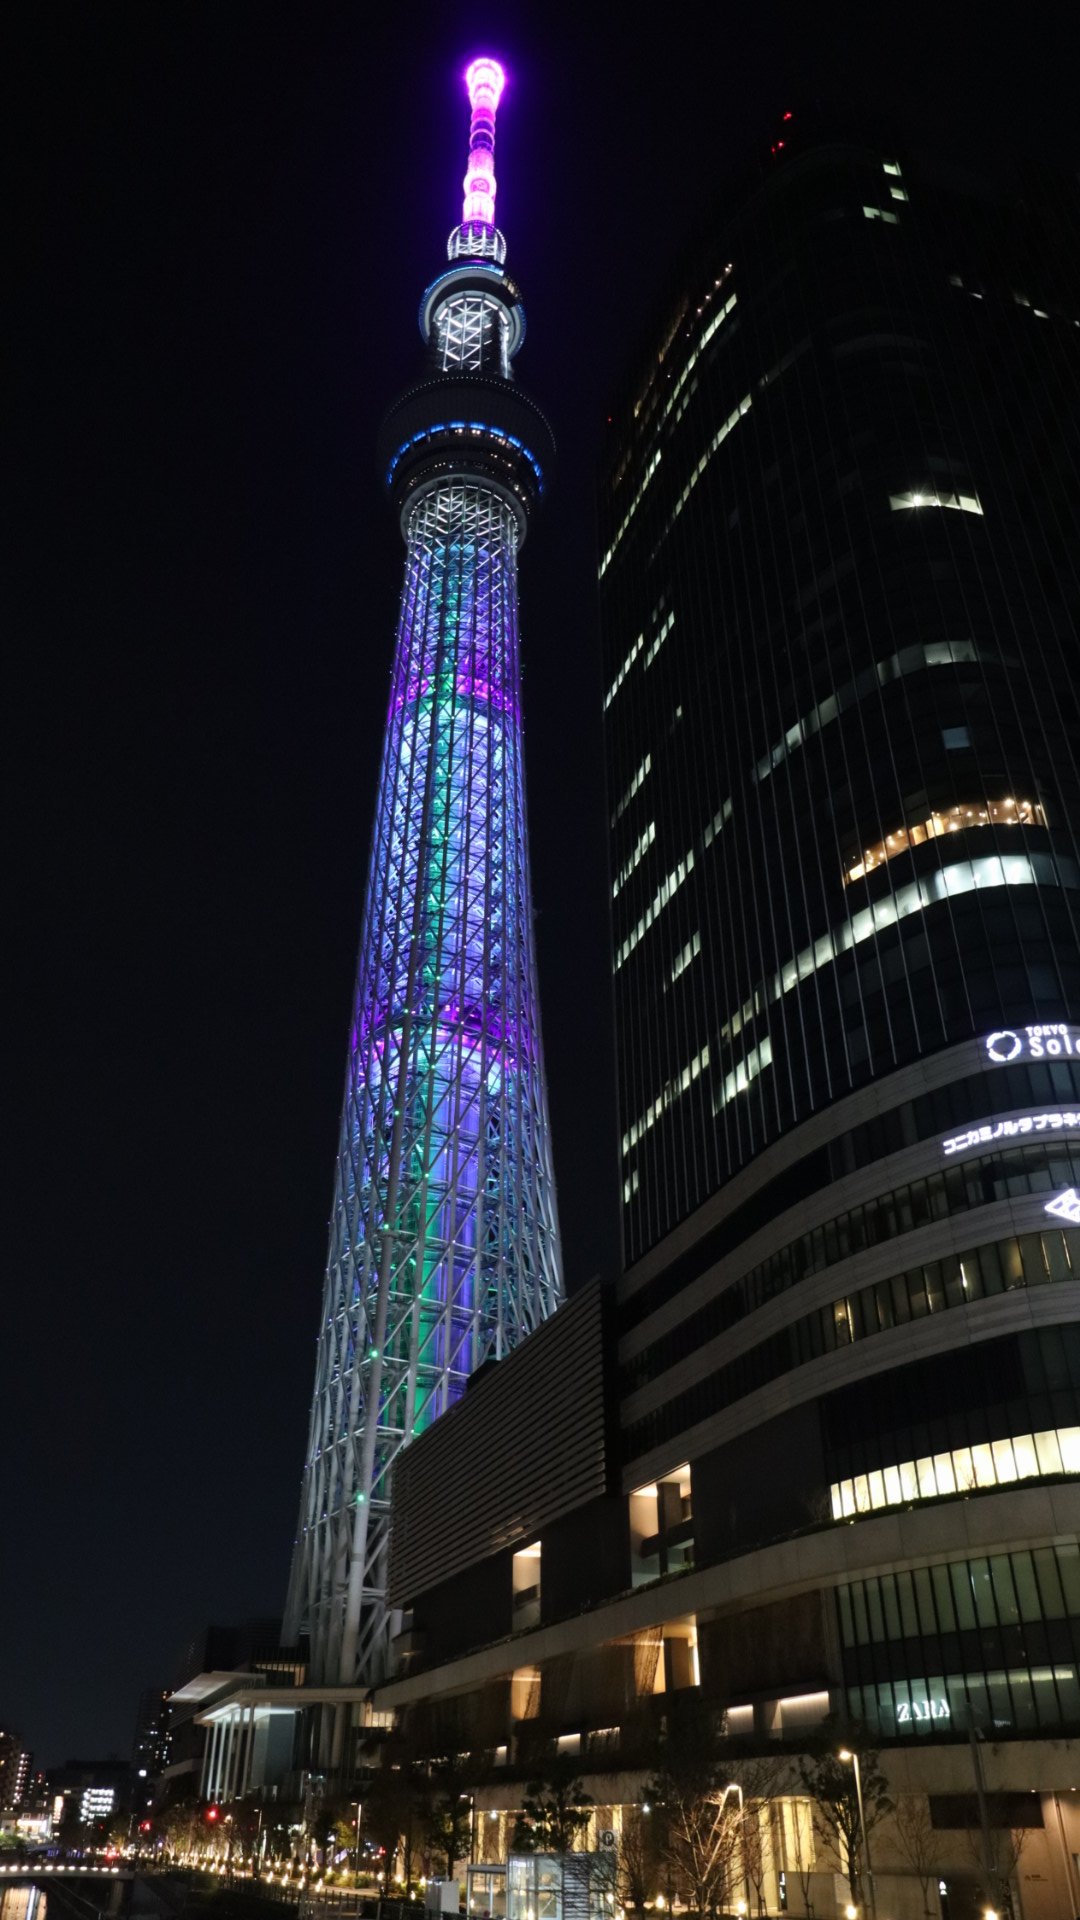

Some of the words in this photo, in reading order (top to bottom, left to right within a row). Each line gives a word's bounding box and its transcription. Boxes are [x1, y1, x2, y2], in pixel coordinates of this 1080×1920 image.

[1025, 1024, 1068, 1037] TOKYO
[943, 1112, 1080, 1155] コニカミノルタプラネ
[897, 1699, 950, 1722] ZARA
